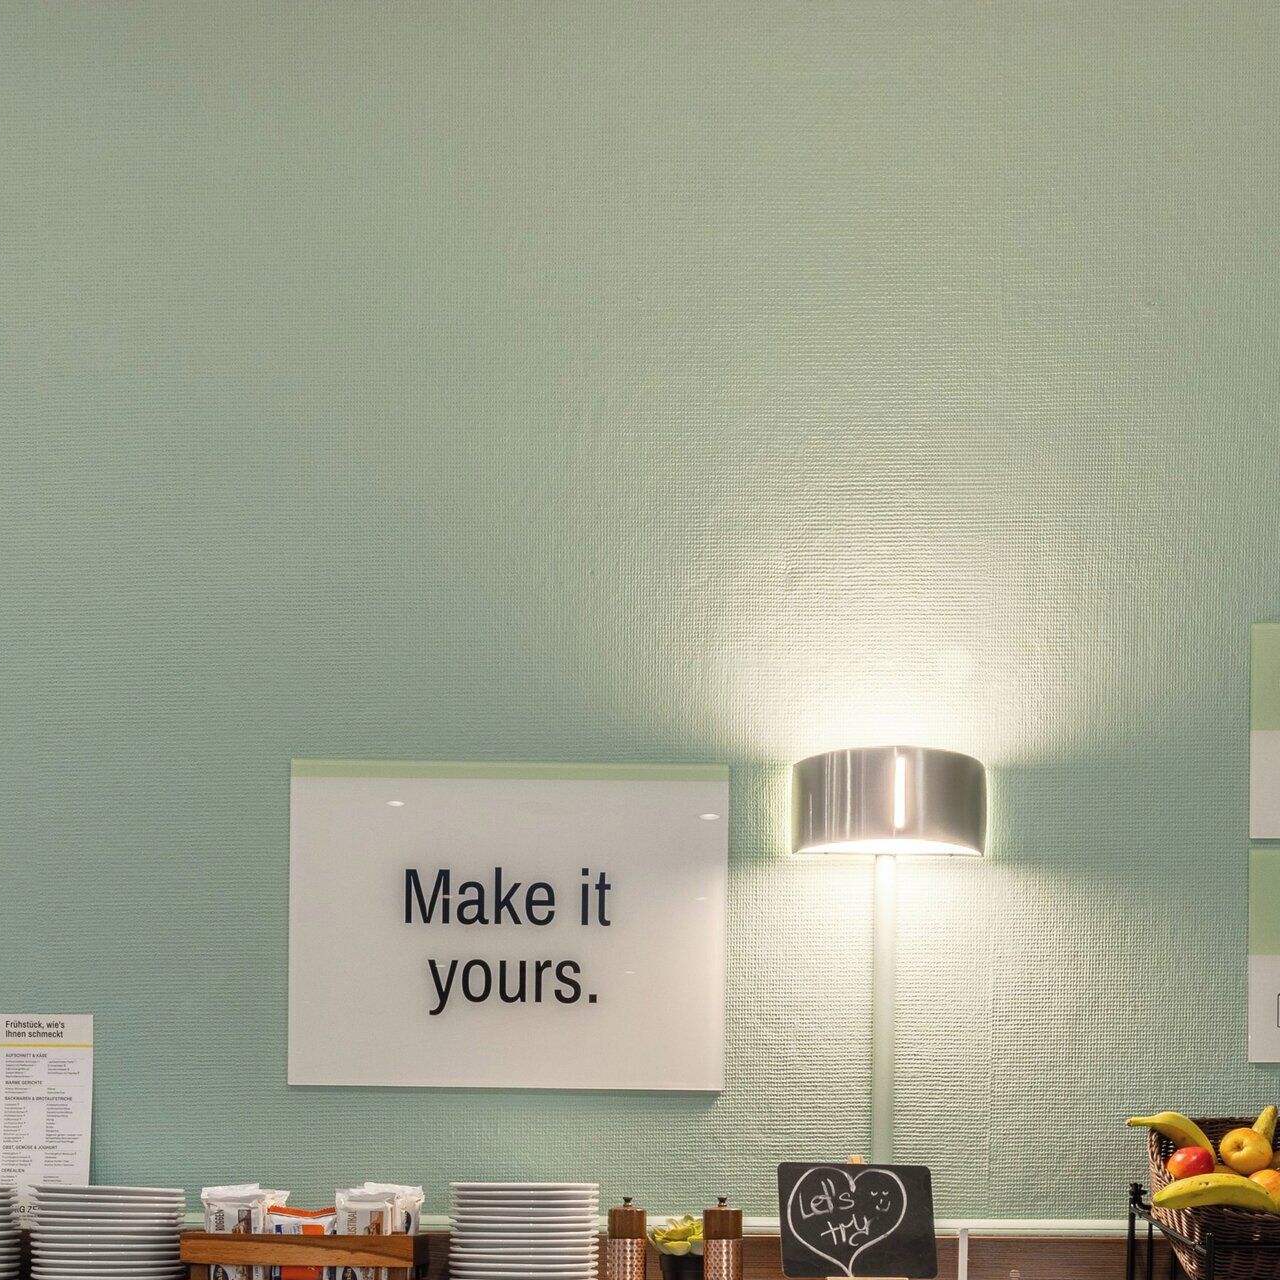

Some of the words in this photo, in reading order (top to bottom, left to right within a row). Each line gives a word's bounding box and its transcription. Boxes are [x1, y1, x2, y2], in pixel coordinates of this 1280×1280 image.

[404, 867, 556, 926] Make
[580, 867, 612, 927] it
[428, 959, 598, 1016] yours.
[5, 1020, 44, 1029] Frühstück,
[46, 1020, 65, 1028] wie's
[28, 1030, 63, 1038] schmeckt
[799, 1178, 855, 1219] Let's
[820, 1214, 871, 1247] try
